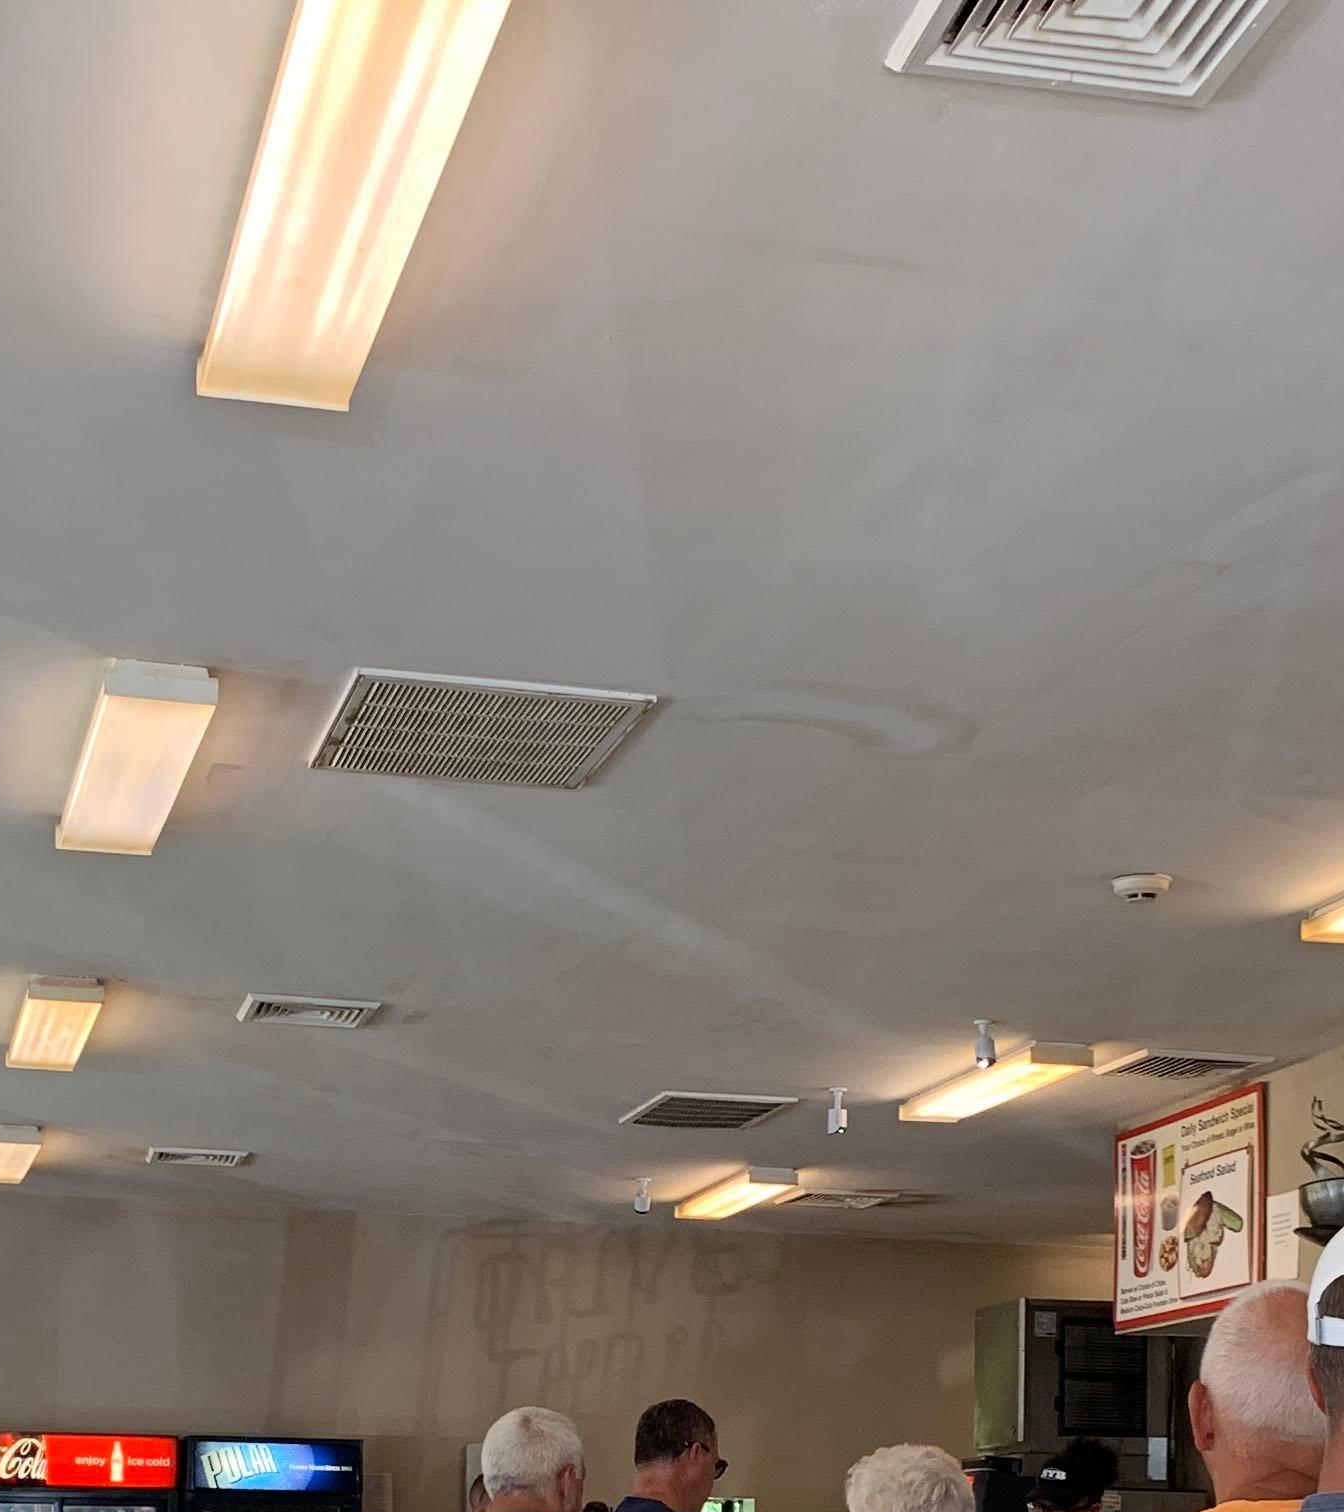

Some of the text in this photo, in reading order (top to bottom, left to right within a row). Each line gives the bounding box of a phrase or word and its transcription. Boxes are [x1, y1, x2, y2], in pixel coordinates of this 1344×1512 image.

[75, 1456, 170, 1468] enjoy ice cold
[200, 1444, 279, 1488] POLAR
